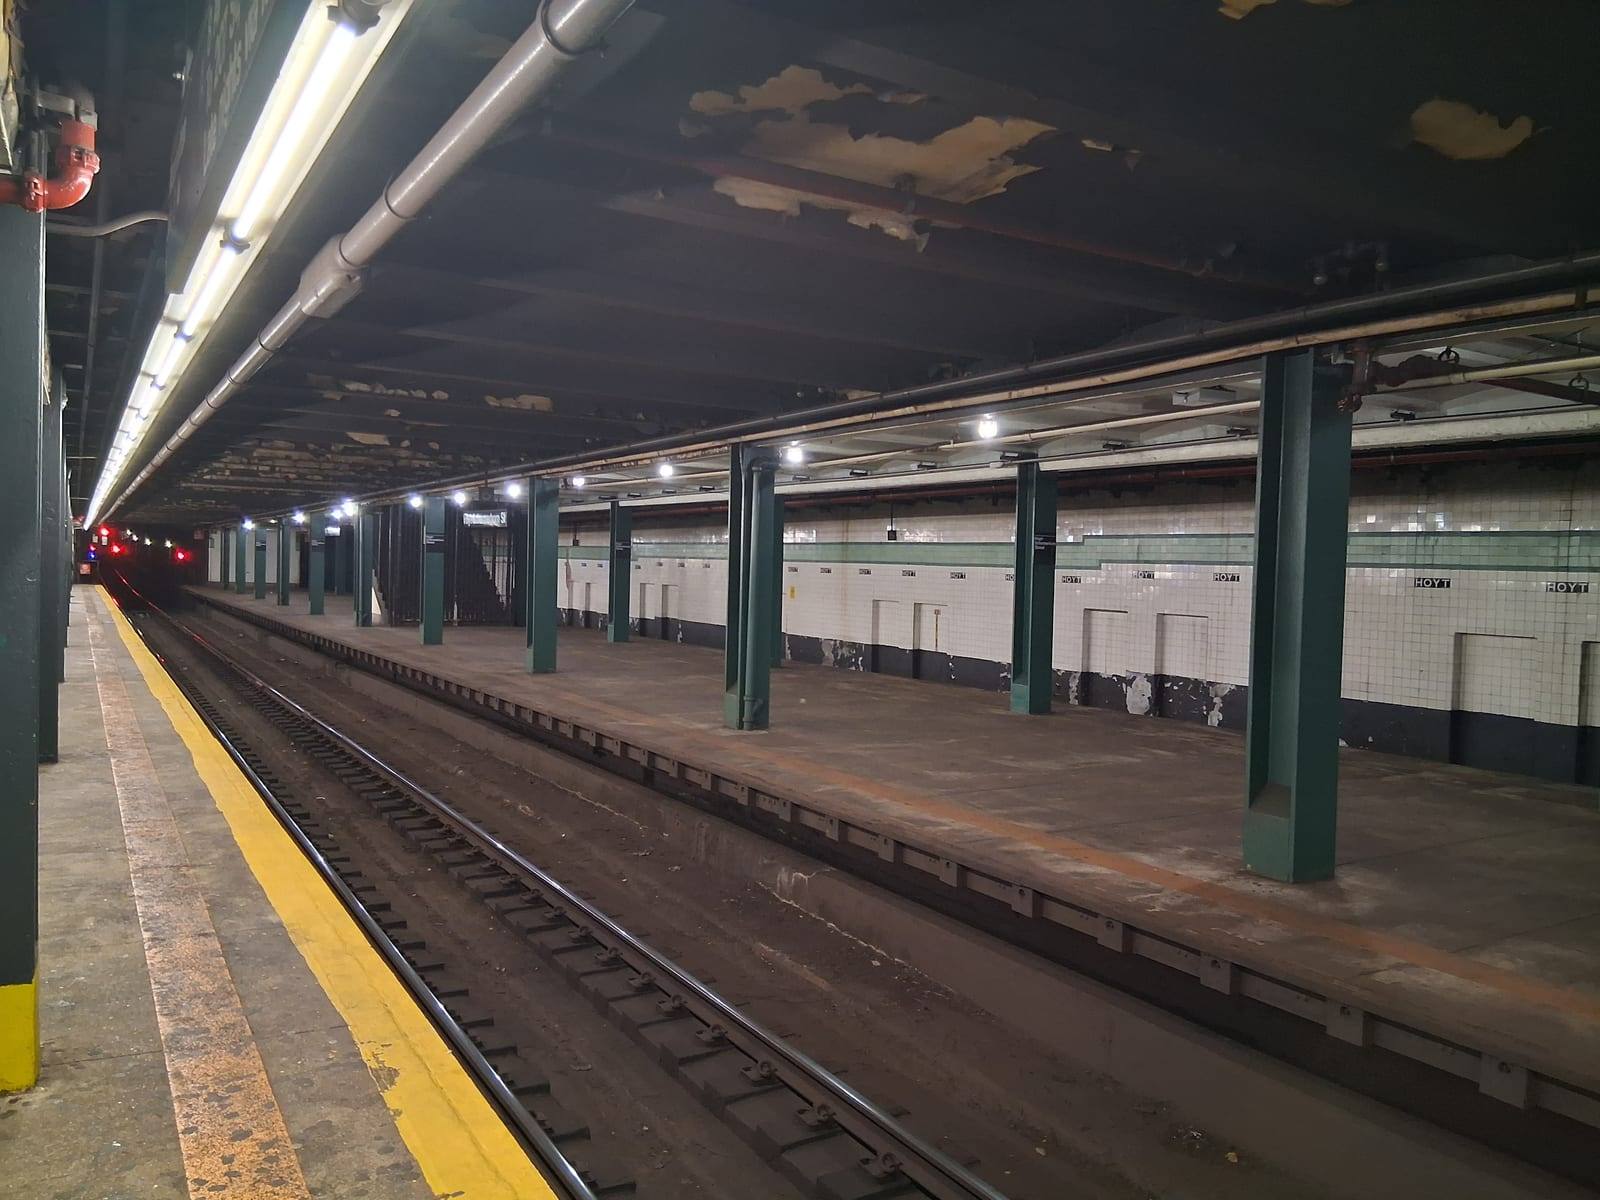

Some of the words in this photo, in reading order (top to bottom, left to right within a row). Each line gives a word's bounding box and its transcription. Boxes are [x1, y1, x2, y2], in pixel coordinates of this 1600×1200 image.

[1132, 571, 1154, 579] HOYT
[1213, 573, 1240, 582] HOYT
[1415, 578, 1450, 588] HOYT
[1547, 582, 1588, 593] HOYT
